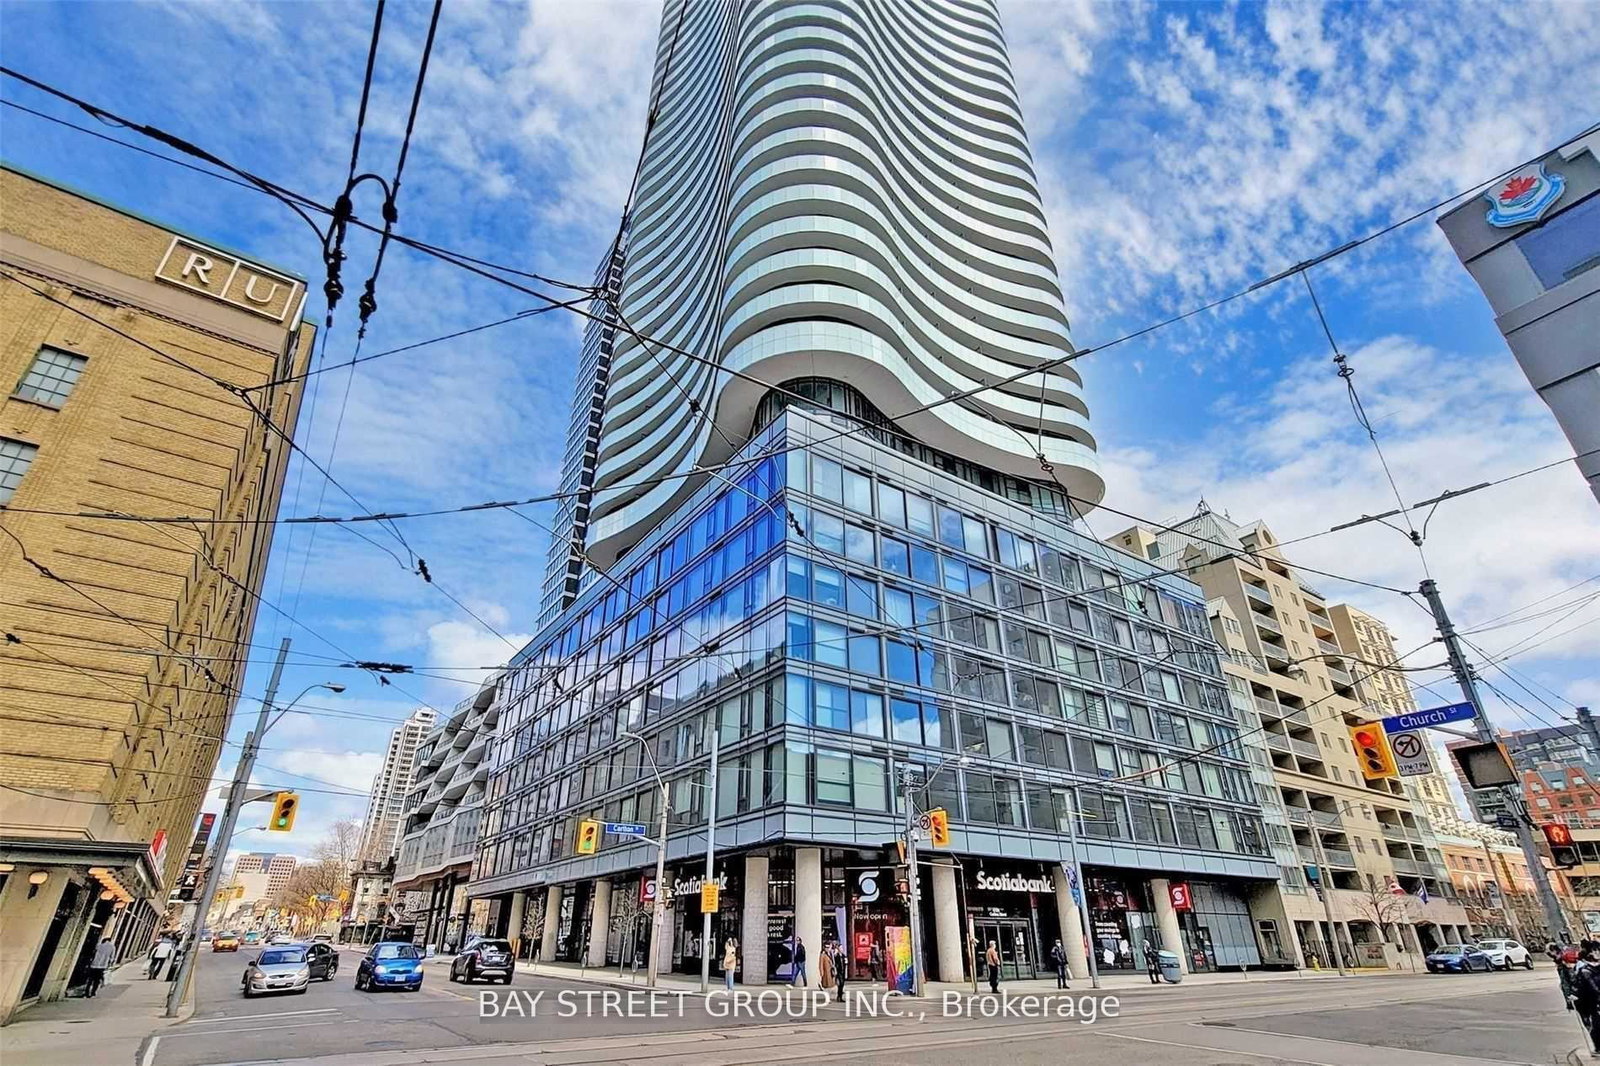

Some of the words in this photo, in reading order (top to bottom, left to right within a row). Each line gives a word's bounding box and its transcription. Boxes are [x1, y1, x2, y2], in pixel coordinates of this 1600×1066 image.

[1400, 710, 1446, 728] Church
[674, 871, 728, 896] Scotiabnk
[976, 870, 1055, 893] Scotiabank
